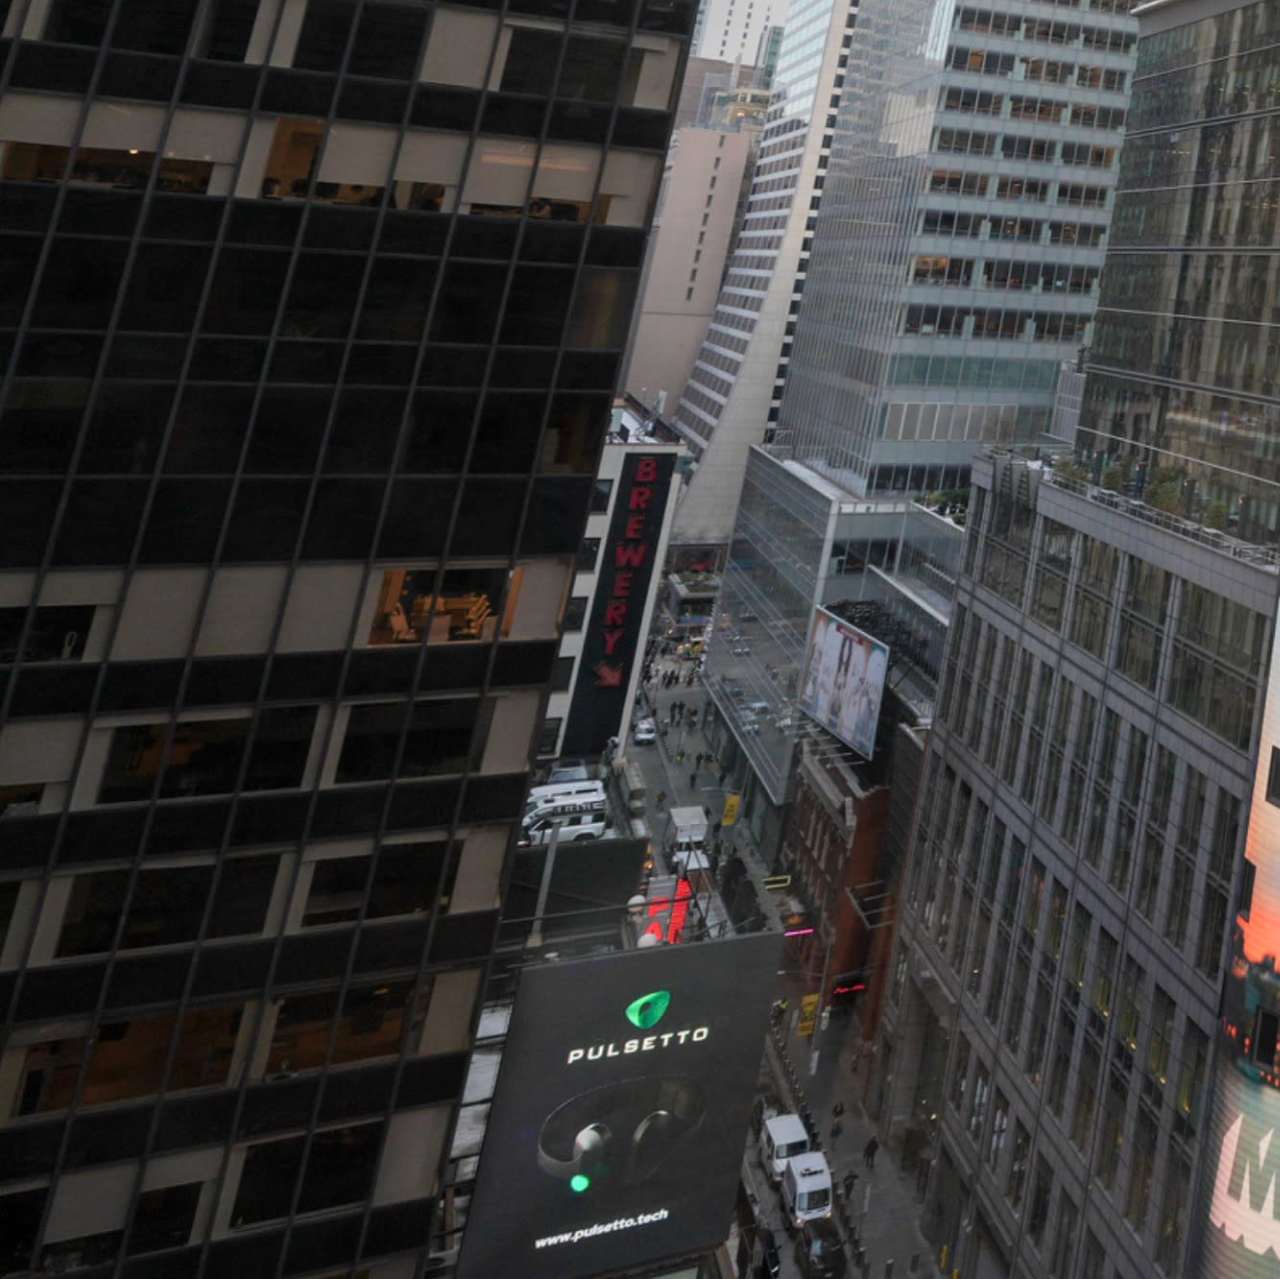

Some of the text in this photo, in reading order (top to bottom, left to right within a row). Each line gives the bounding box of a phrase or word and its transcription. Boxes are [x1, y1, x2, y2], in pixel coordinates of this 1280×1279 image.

[602, 456, 658, 656] BREWERY
[567, 1026, 709, 1064] PULSETTO
[535, 1208, 669, 1249] www.pulsetto.tech
